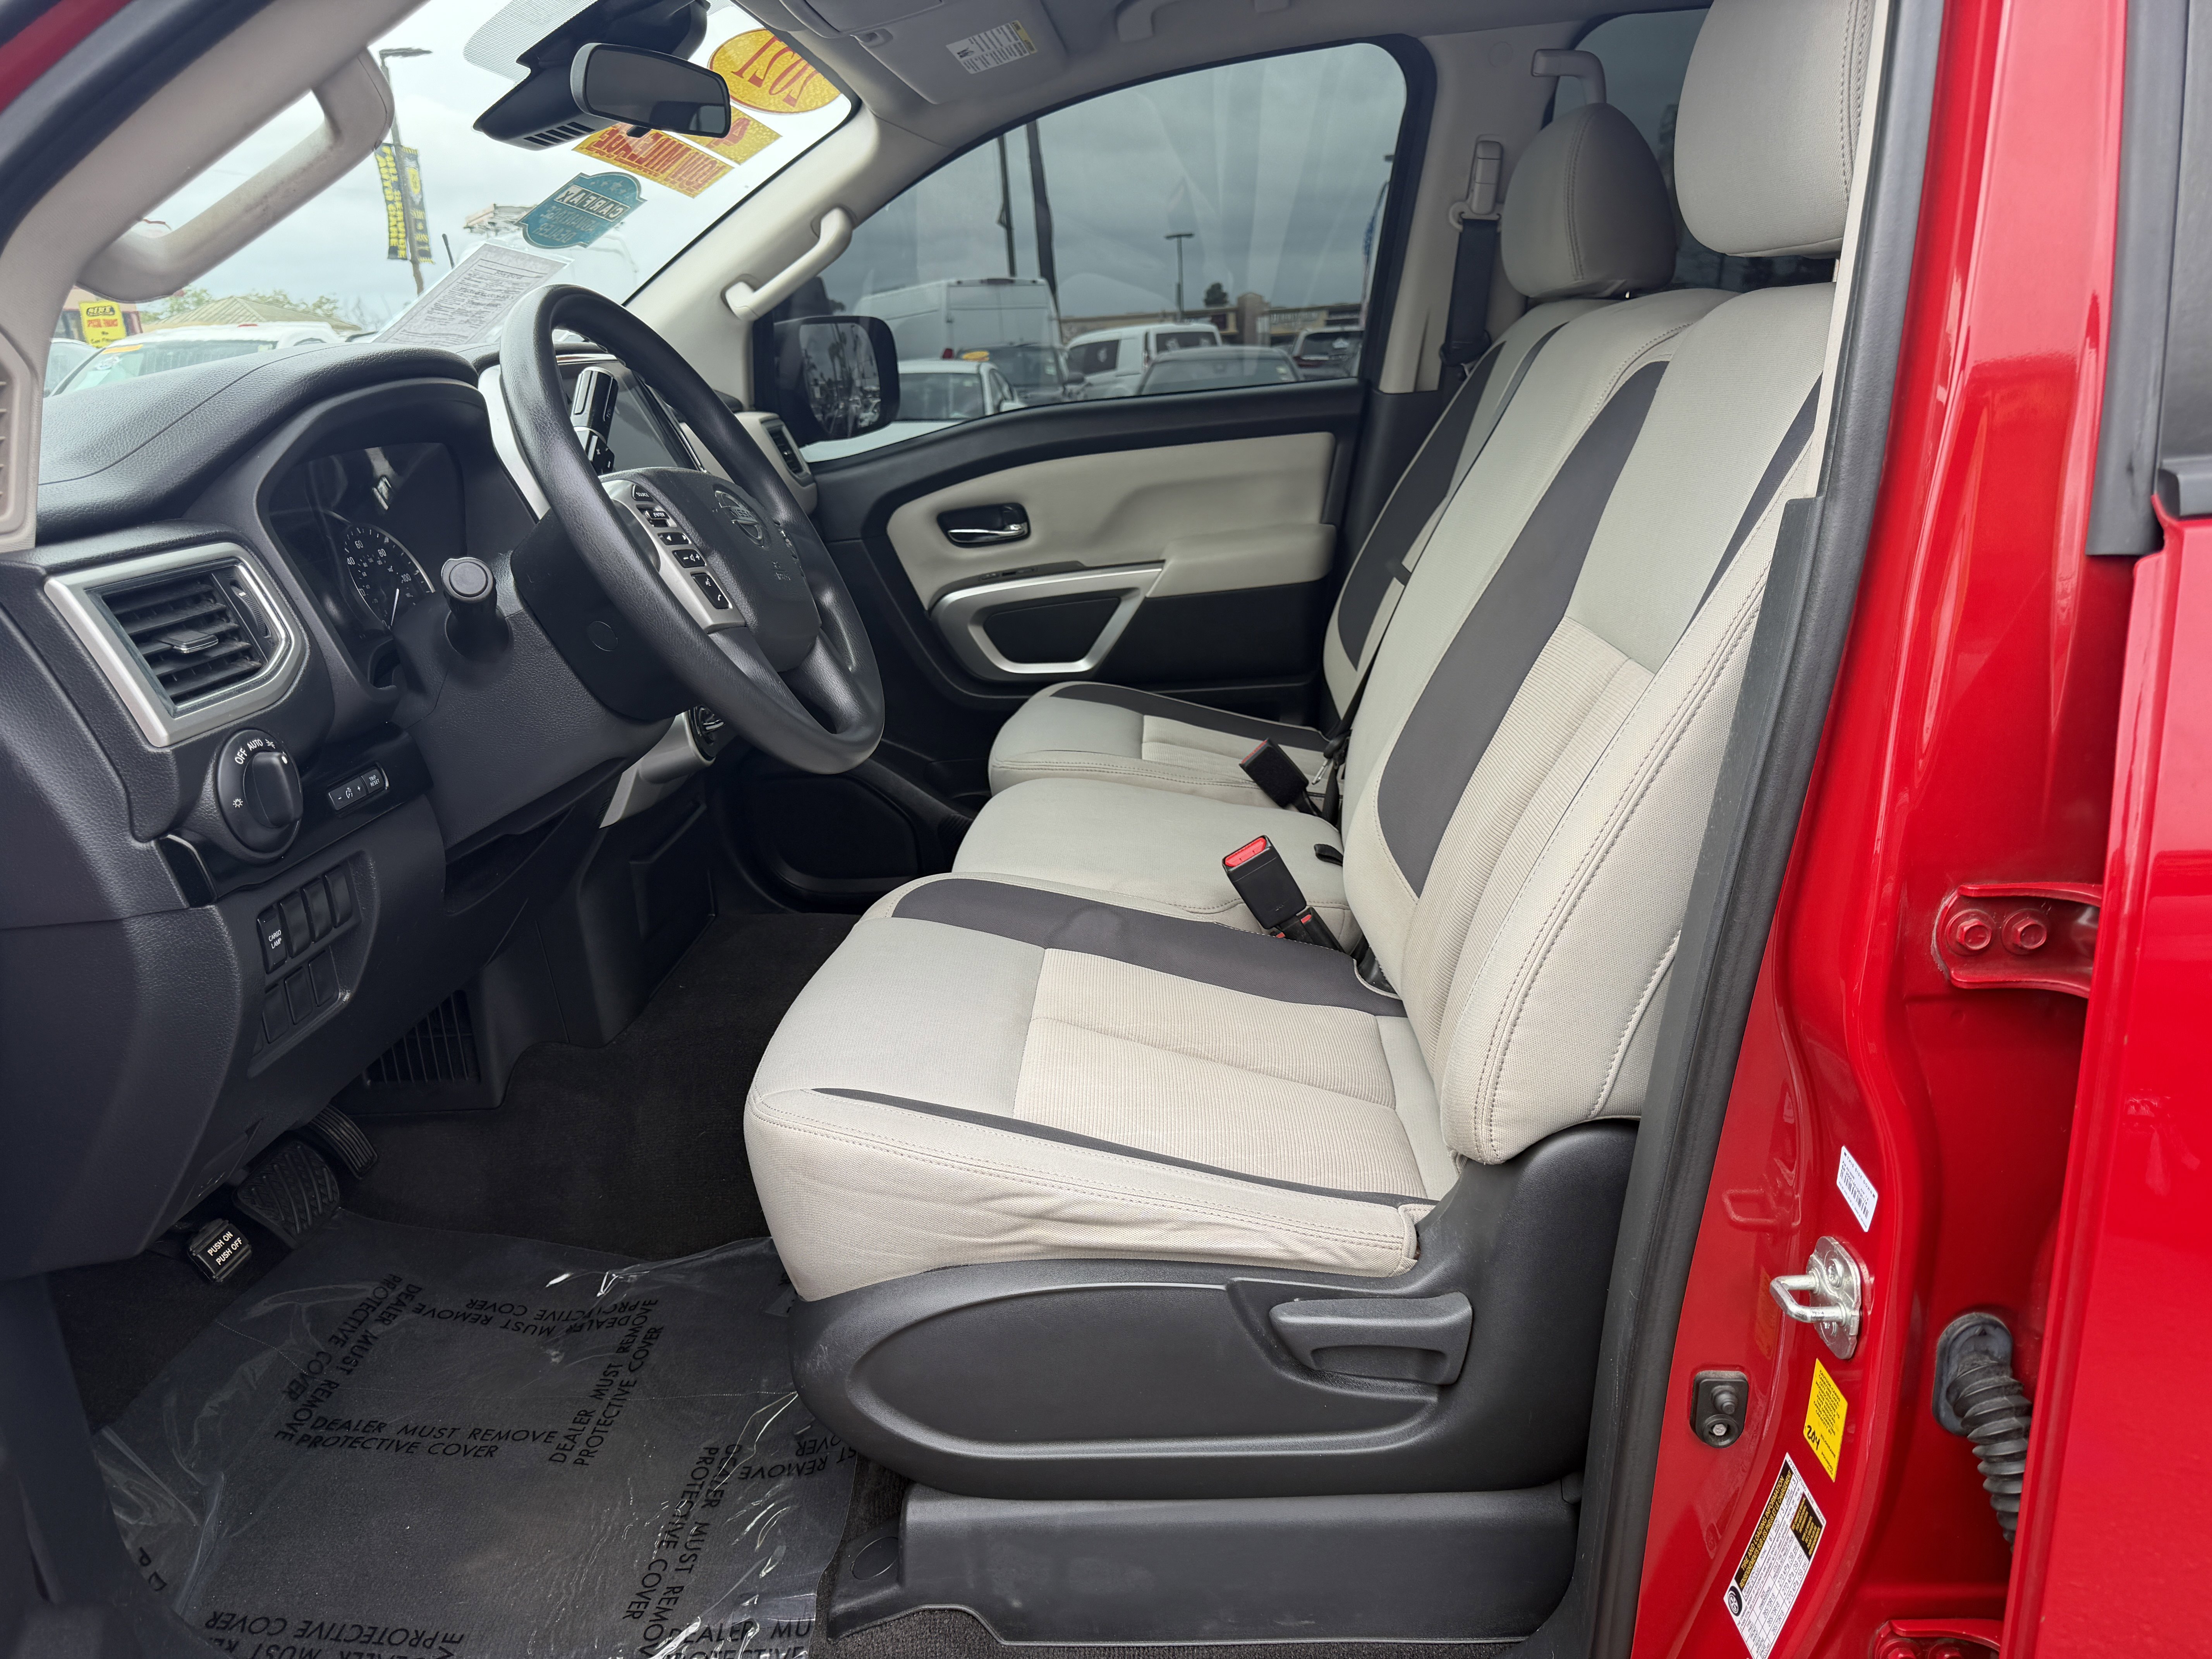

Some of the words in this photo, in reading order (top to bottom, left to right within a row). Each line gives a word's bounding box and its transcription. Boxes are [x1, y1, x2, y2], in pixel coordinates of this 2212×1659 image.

[729, 508, 755, 520] NISSA
[355, 540, 364, 549] 60
[378, 548, 386, 557] 80
[347, 557, 356, 565] 40
[401, 573, 412, 582] 100
[235, 748, 248, 764] OFF
[247, 739, 263, 751] AUTO
[370, 779, 380, 787] RESET
[269, 929, 281, 941] CARGO
[271, 938, 282, 949] LAMP
[207, 1240, 225, 1256] PUSH
[223, 1231, 233, 1241] ON
[216, 1248, 232, 1265] PUSH
[231, 1237, 242, 1250] OFF
[328, 1273, 403, 1349] PROTECTIVE
[375, 1283, 423, 1326] DEALER
[412, 1302, 493, 1327] REMOVE
[465, 1298, 528, 1317] COVER
[500, 1318, 556, 1337] MUST
[336, 1329, 379, 1375] MUST
[282, 1350, 332, 1402] COVER
[548, 1409, 596, 1465] DEALER
[588, 1362, 624, 1400] MUST
[616, 1298, 659, 1354] REMOVE
[573, 1379, 637, 1467] PROTECTIVE
[628, 1326, 665, 1374] COVER
[274, 1379, 340, 1441] REMOVE
[311, 1416, 388, 1434] DEALER
[397, 1425, 460, 1440] MUST
[467, 1427, 559, 1444] REMOVE
[295, 1434, 421, 1454] PROTECTIVE
[428, 1443, 500, 1458] COVER
[795, 1435, 842, 1457] OVER
[836, 1448, 857, 1465] ST
[738, 1455, 828, 1480] REMOVE
[1753, 1517, 1767, 1544] LOADING
[1765, 1476, 1784, 1518] INFORMATION
[1765, 1514, 1774, 1531] PNEUS
[1772, 1507, 1776, 1516] ET
[1775, 1501, 1779, 1510] LE
[1778, 1470, 1791, 1503] CHARGEMENT
[674, 1521, 711, 1575] MUST
[622, 1558, 668, 1620] COVER
[1763, 1593, 1775, 1618] 265/70R18
[1767, 1601, 1780, 1627] 265/70R18
[204, 1610, 288, 1637] COVER
[638, 1585, 685, 1659] REMOV
[1772, 1608, 1784, 1635] 265/70R18
[294, 1620, 442, 1649] PROTECTIVE
